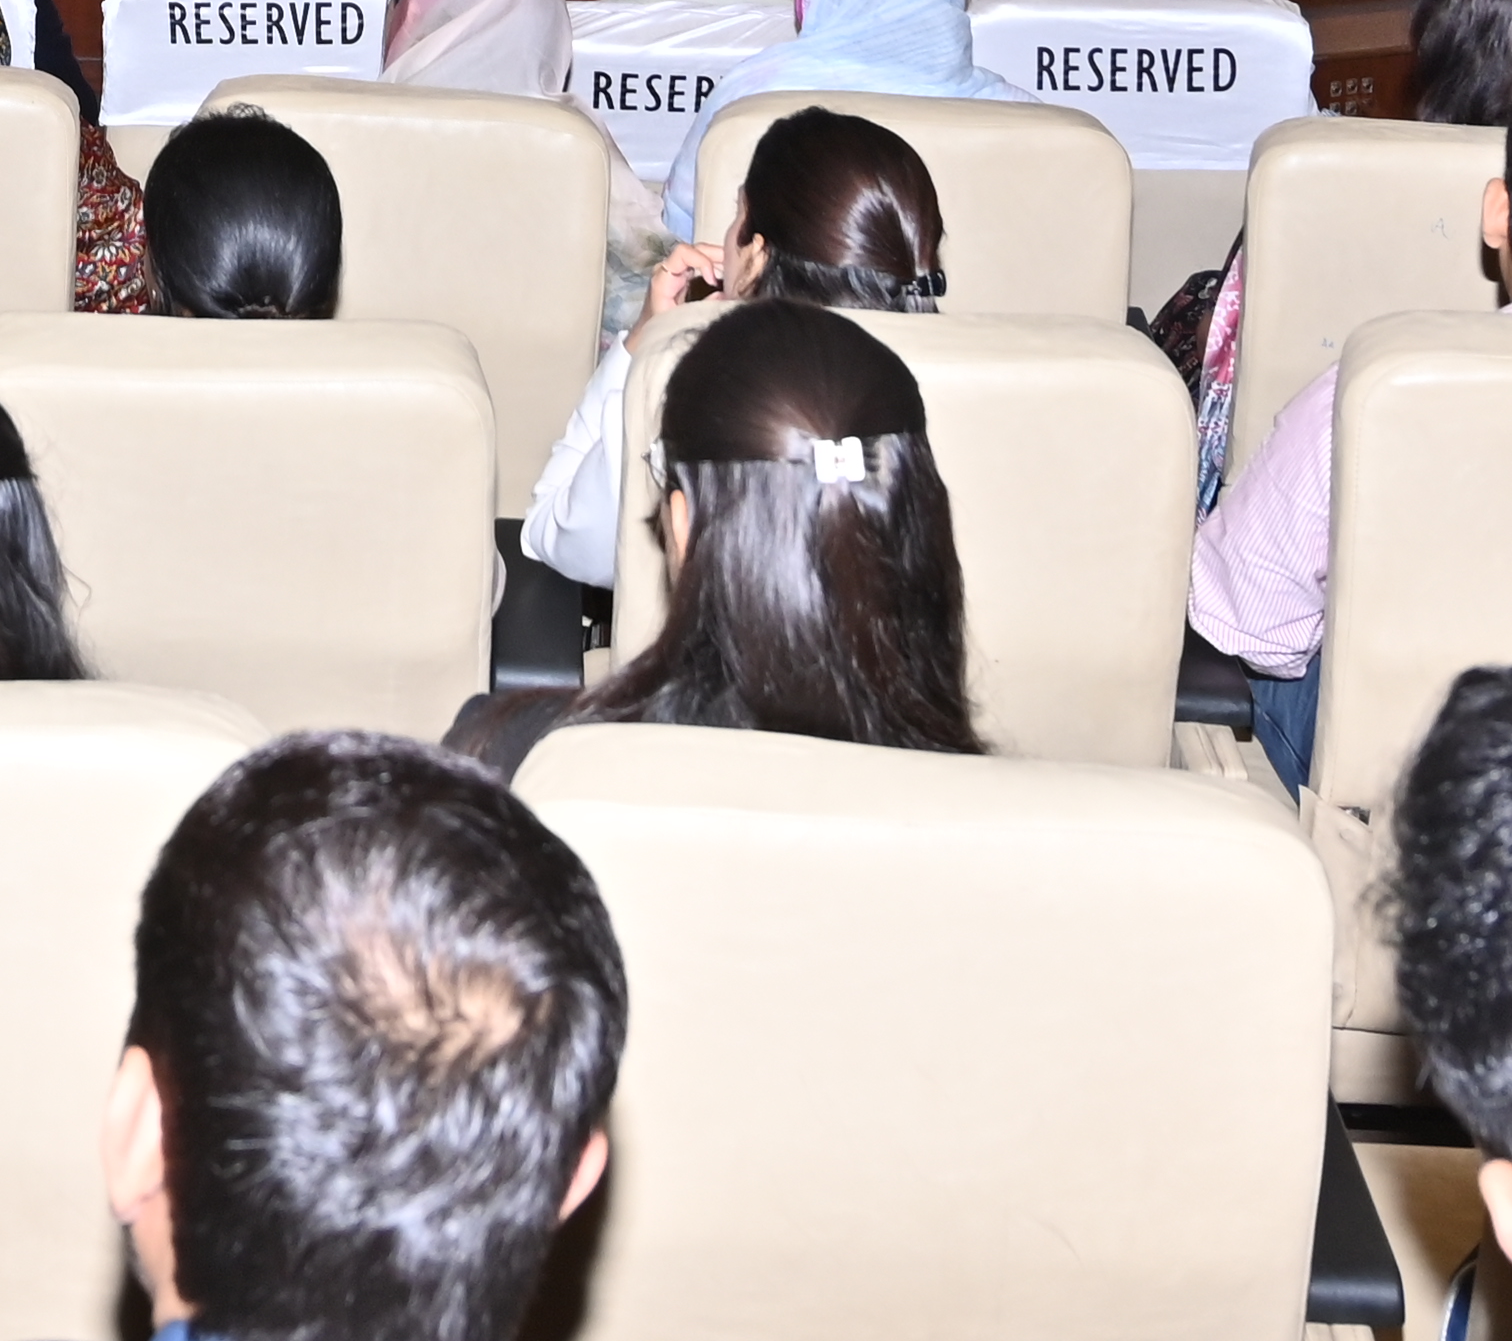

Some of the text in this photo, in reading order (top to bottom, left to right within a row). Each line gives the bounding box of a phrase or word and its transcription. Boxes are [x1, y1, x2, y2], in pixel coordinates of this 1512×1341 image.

[169, 2, 364, 45] RESERVED
[1037, 47, 1236, 92] RESERVED
[592, 71, 712, 113] RESER
